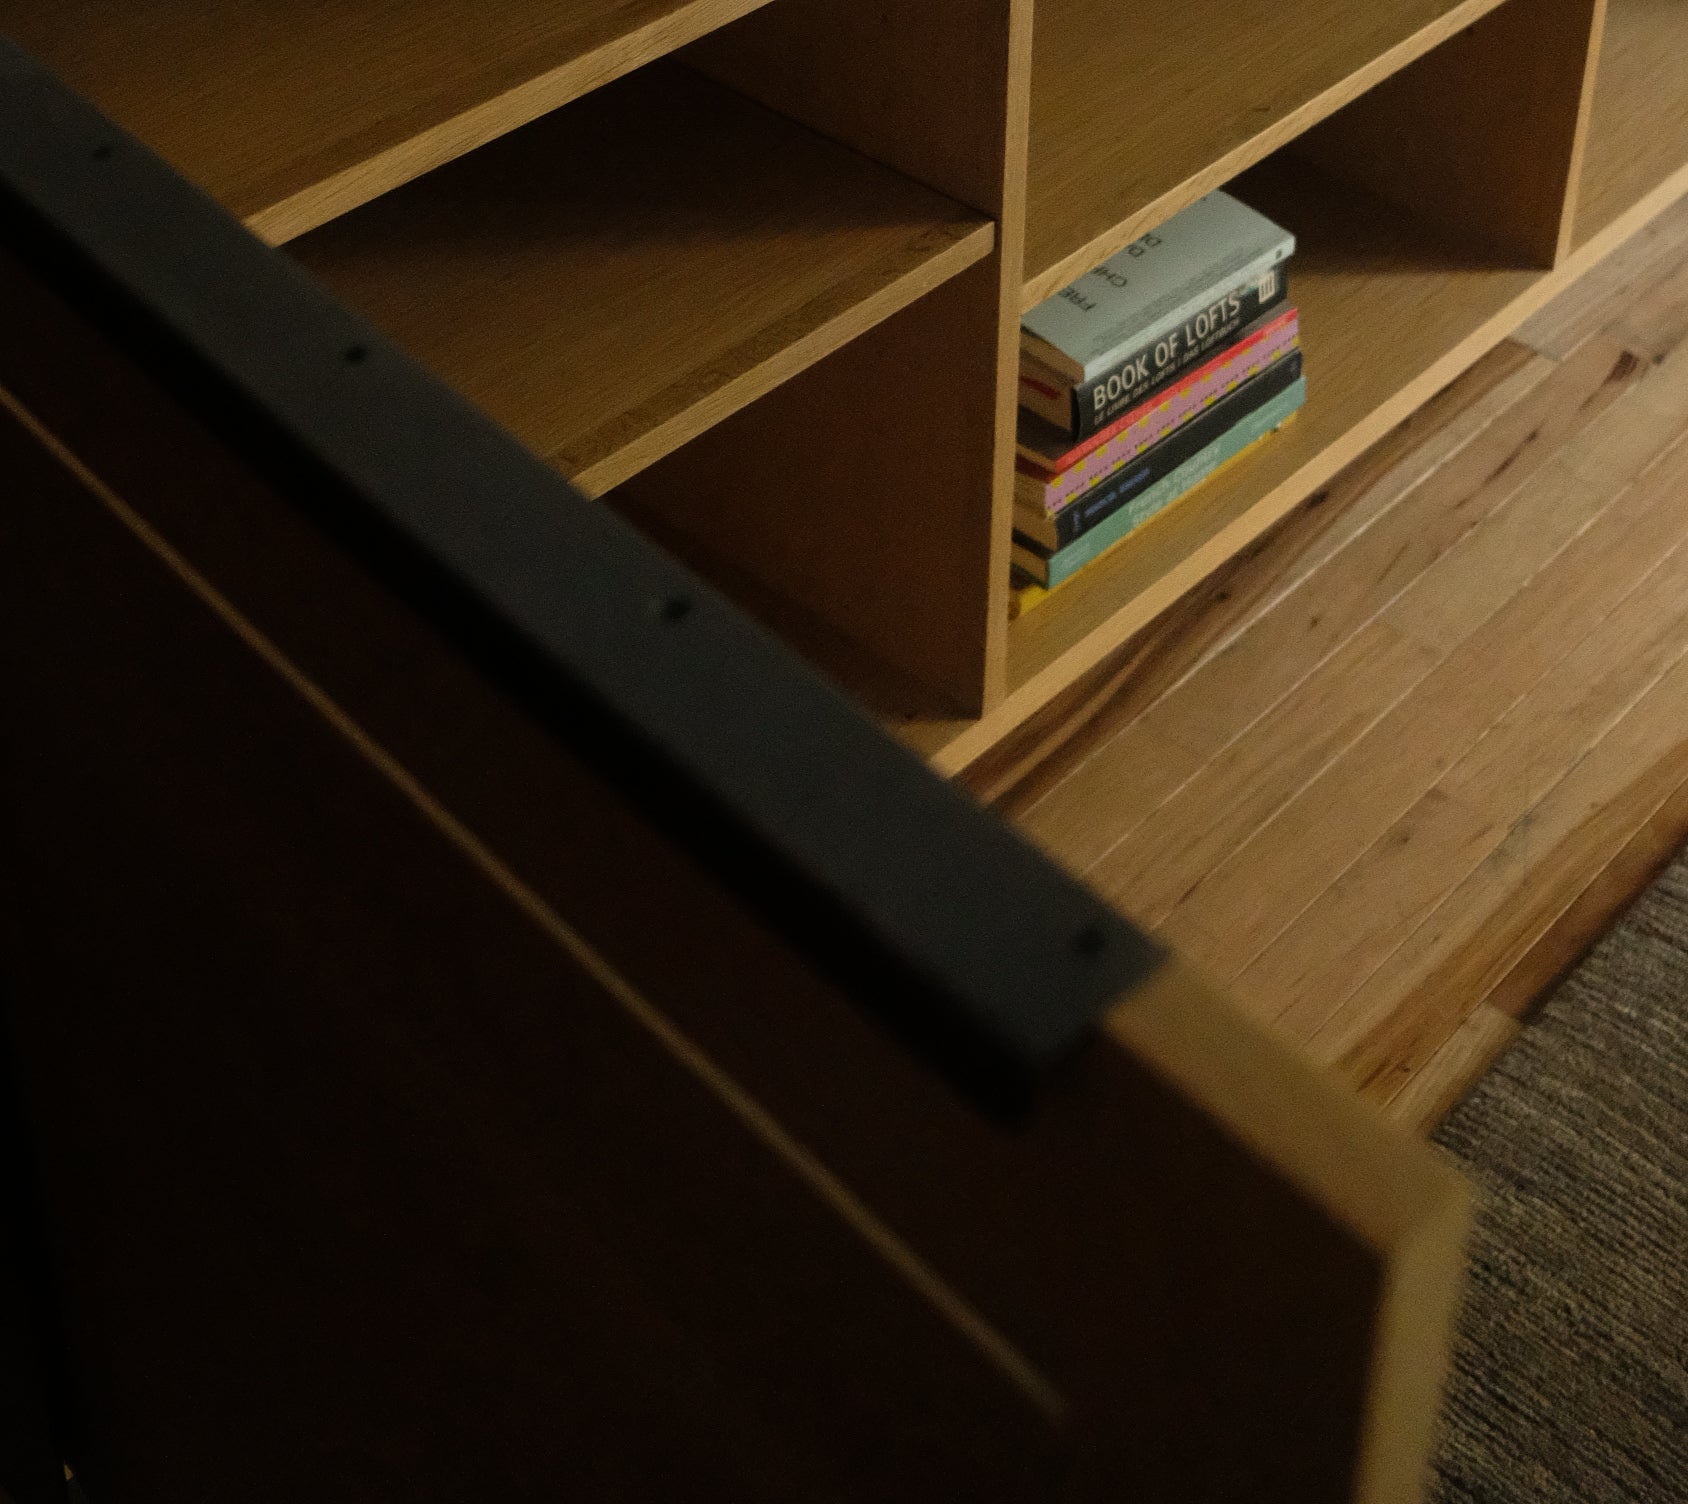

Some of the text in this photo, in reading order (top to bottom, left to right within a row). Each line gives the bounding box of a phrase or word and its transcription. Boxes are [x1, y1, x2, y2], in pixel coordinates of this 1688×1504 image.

[1093, 354, 1149, 410] BOOK
[1155, 332, 1178, 367] OF
[1185, 290, 1240, 346] LOFTS
